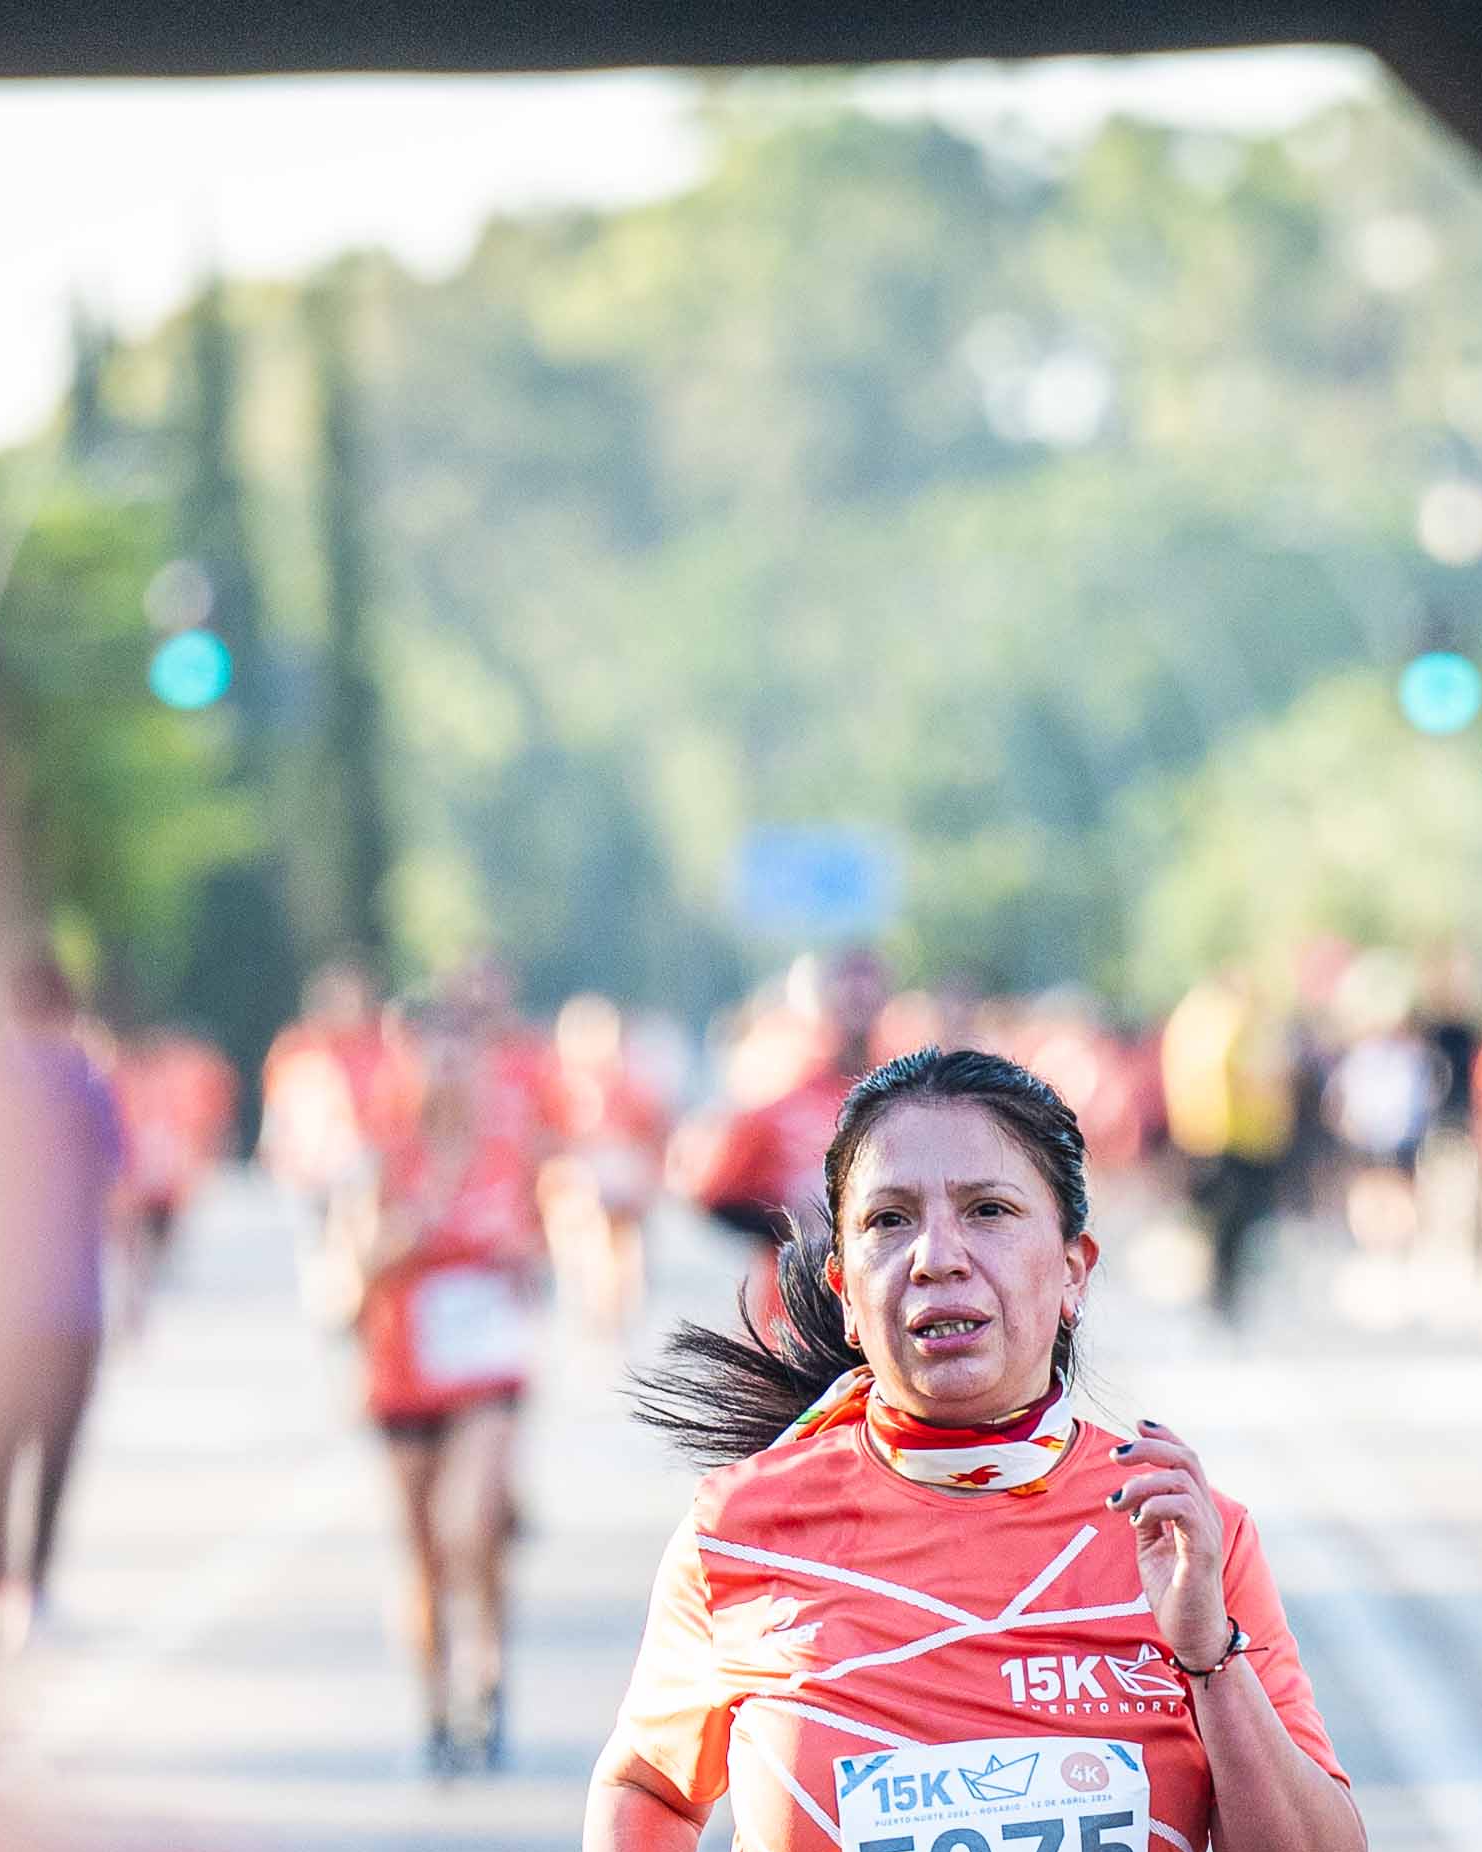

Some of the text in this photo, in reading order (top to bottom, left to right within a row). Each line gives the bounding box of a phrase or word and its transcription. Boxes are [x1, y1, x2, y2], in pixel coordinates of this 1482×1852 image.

[1000, 1656, 1107, 1702] 15K
[872, 1764, 1100, 1813] 15K 4K
